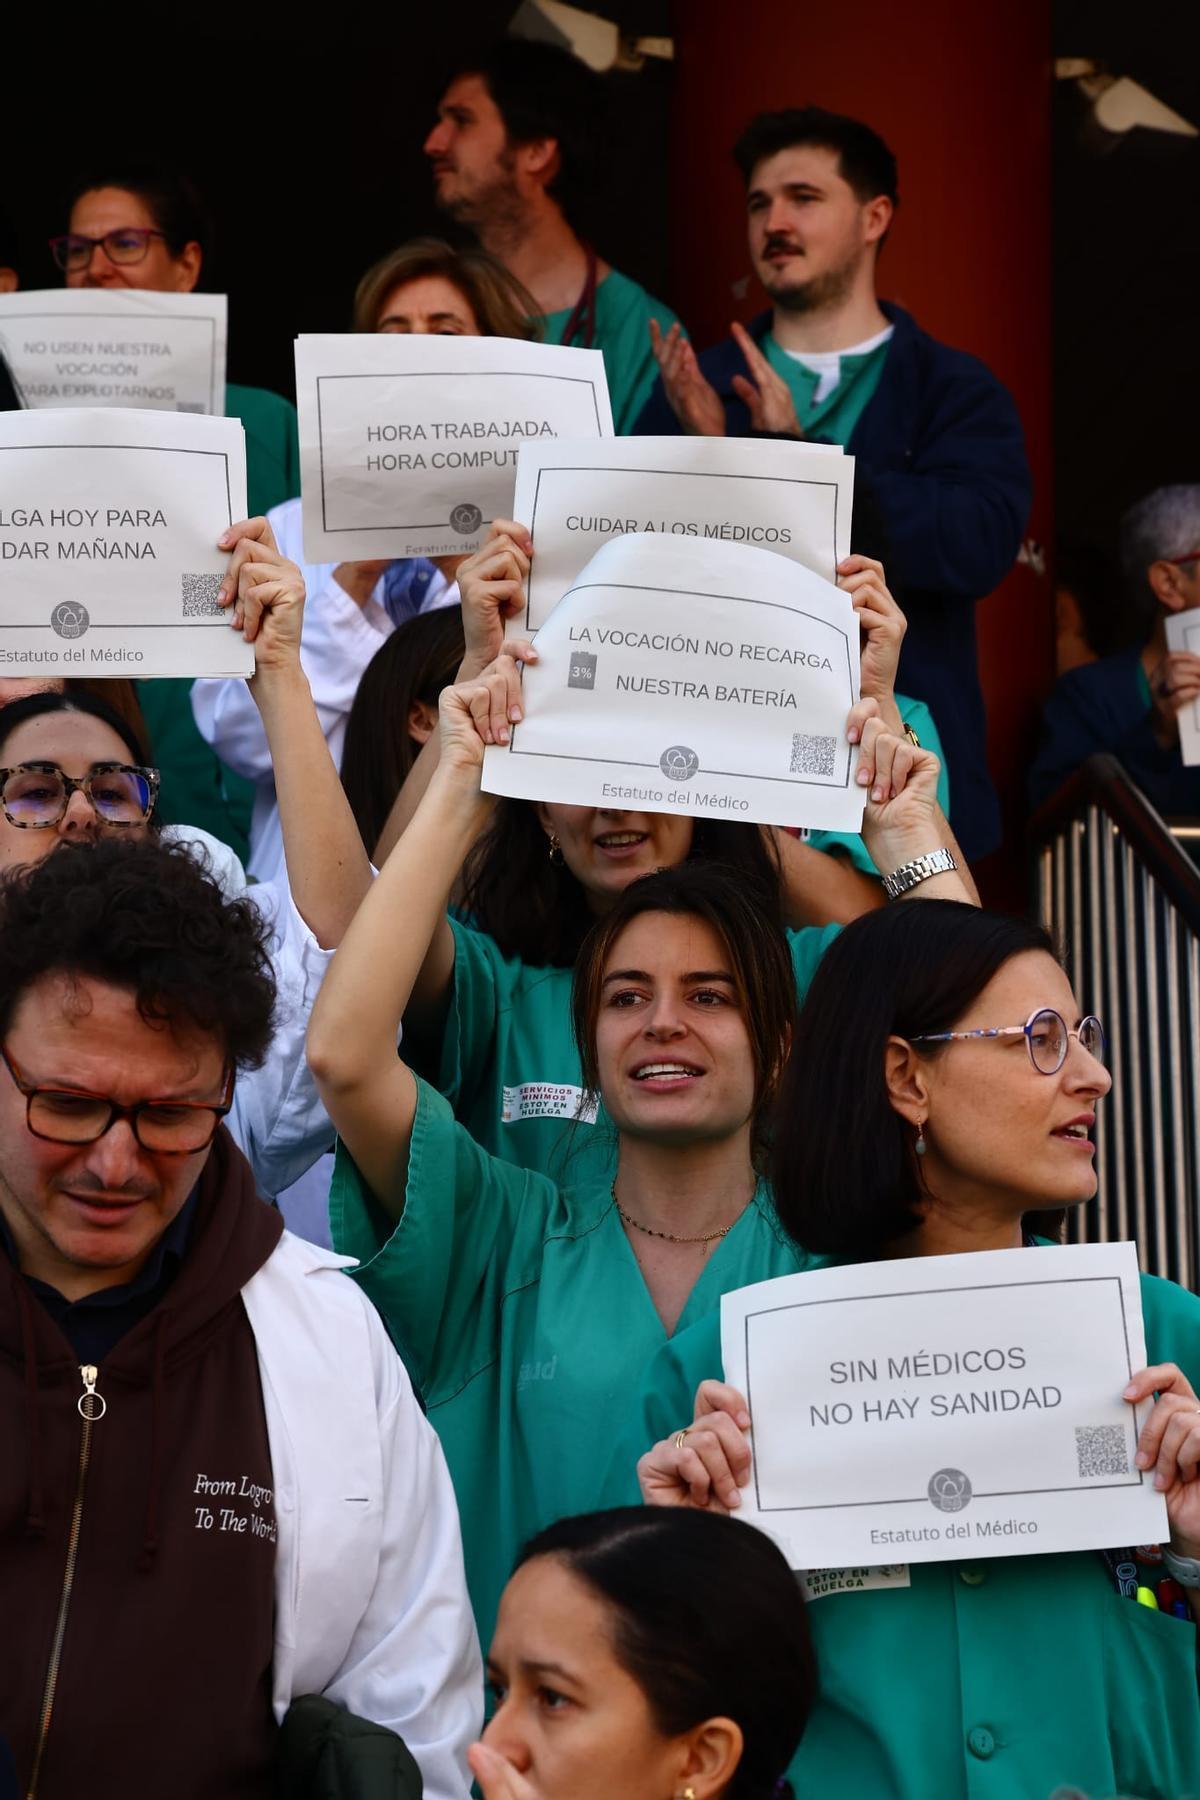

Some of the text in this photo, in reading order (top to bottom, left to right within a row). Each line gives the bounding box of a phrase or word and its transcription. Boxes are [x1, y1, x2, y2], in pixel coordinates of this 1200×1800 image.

[24, 342, 172, 356] NO USEN NUESTRA
[56, 361, 138, 376] VOCACIÓN
[62, 383, 176, 400] EXPLOTARNOS
[367, 421, 558, 442] HORA TRABAJADA,
[367, 454, 427, 471] HORA
[51, 509, 98, 526] HOY
[107, 510, 167, 527] PARA
[566, 515, 637, 533] CUIDAR
[644, 520, 655, 533] A
[704, 521, 792, 543] MÉDICOS
[2, 537, 156, 559] DAR MAÑANA
[63, 648, 85, 661] del
[91, 648, 143, 661] Médico
[569, 627, 833, 672] LA VOCACIÓN NO RECARGA
[572, 665, 592, 680] 3%
[616, 675, 798, 708] NUESTRA BATERÍA
[602, 783, 749, 811] Estatuto del Médico
[520, 1087, 572, 1095] SERVICIOS
[520, 1101, 549, 1109] ESTOY
[522, 1108, 561, 1116] HUELGA
[830, 1346, 1027, 1384] SIN MÉDICOS
[810, 1386, 1062, 1427] NO HAY SANIDAD
[194, 1474, 273, 1508] From Logro
[195, 1508, 213, 1529] To
[220, 1509, 247, 1532] The
[870, 1519, 1038, 1545] Estatuto del Médico
[807, 1571, 845, 1586] ESTOY
[852, 1569, 869, 1578] EN
[813, 1579, 864, 1594] HUELGA
